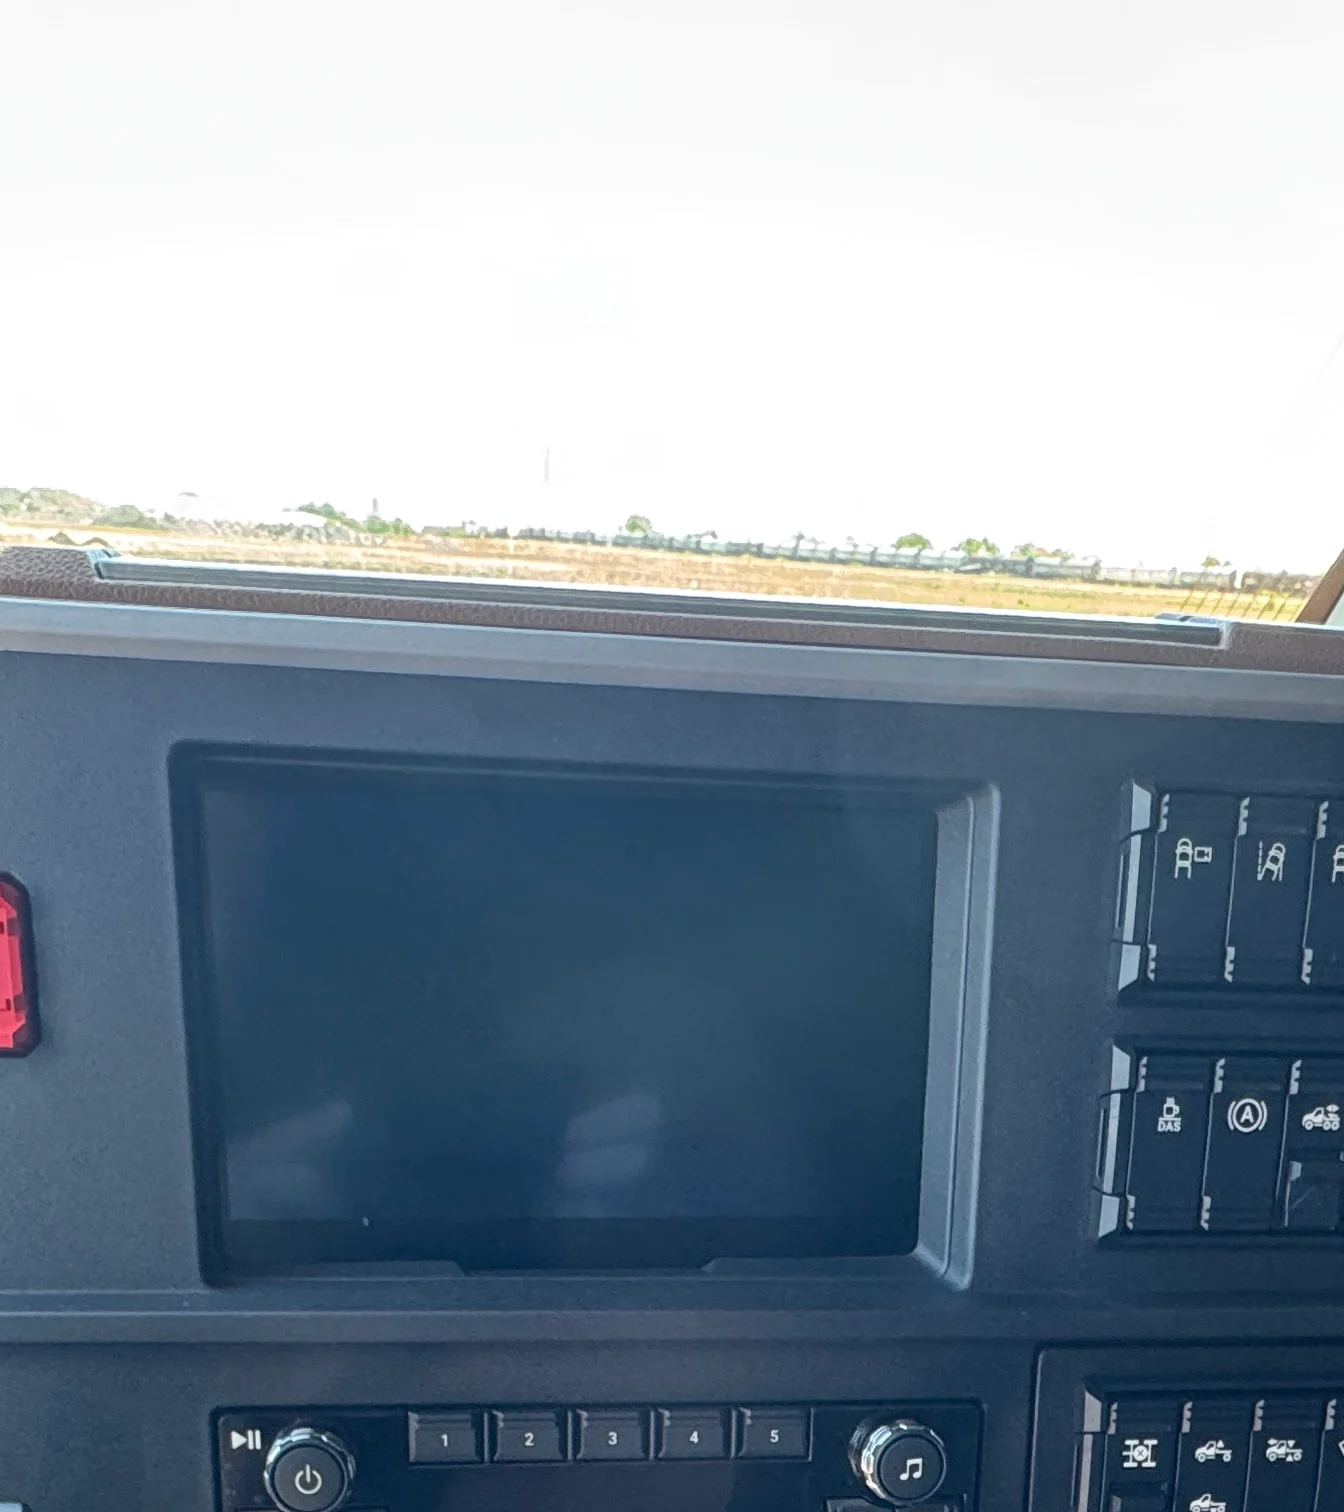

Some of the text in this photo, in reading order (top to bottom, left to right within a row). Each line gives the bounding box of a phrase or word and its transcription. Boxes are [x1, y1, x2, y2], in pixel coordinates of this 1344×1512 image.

[1157, 1120, 1182, 1132] DAS
[441, 1433, 448, 1447] 1
[524, 1432, 535, 1447] 2
[608, 1431, 618, 1446] 3
[689, 1430, 699, 1444] 4
[770, 1429, 779, 1443] 5
